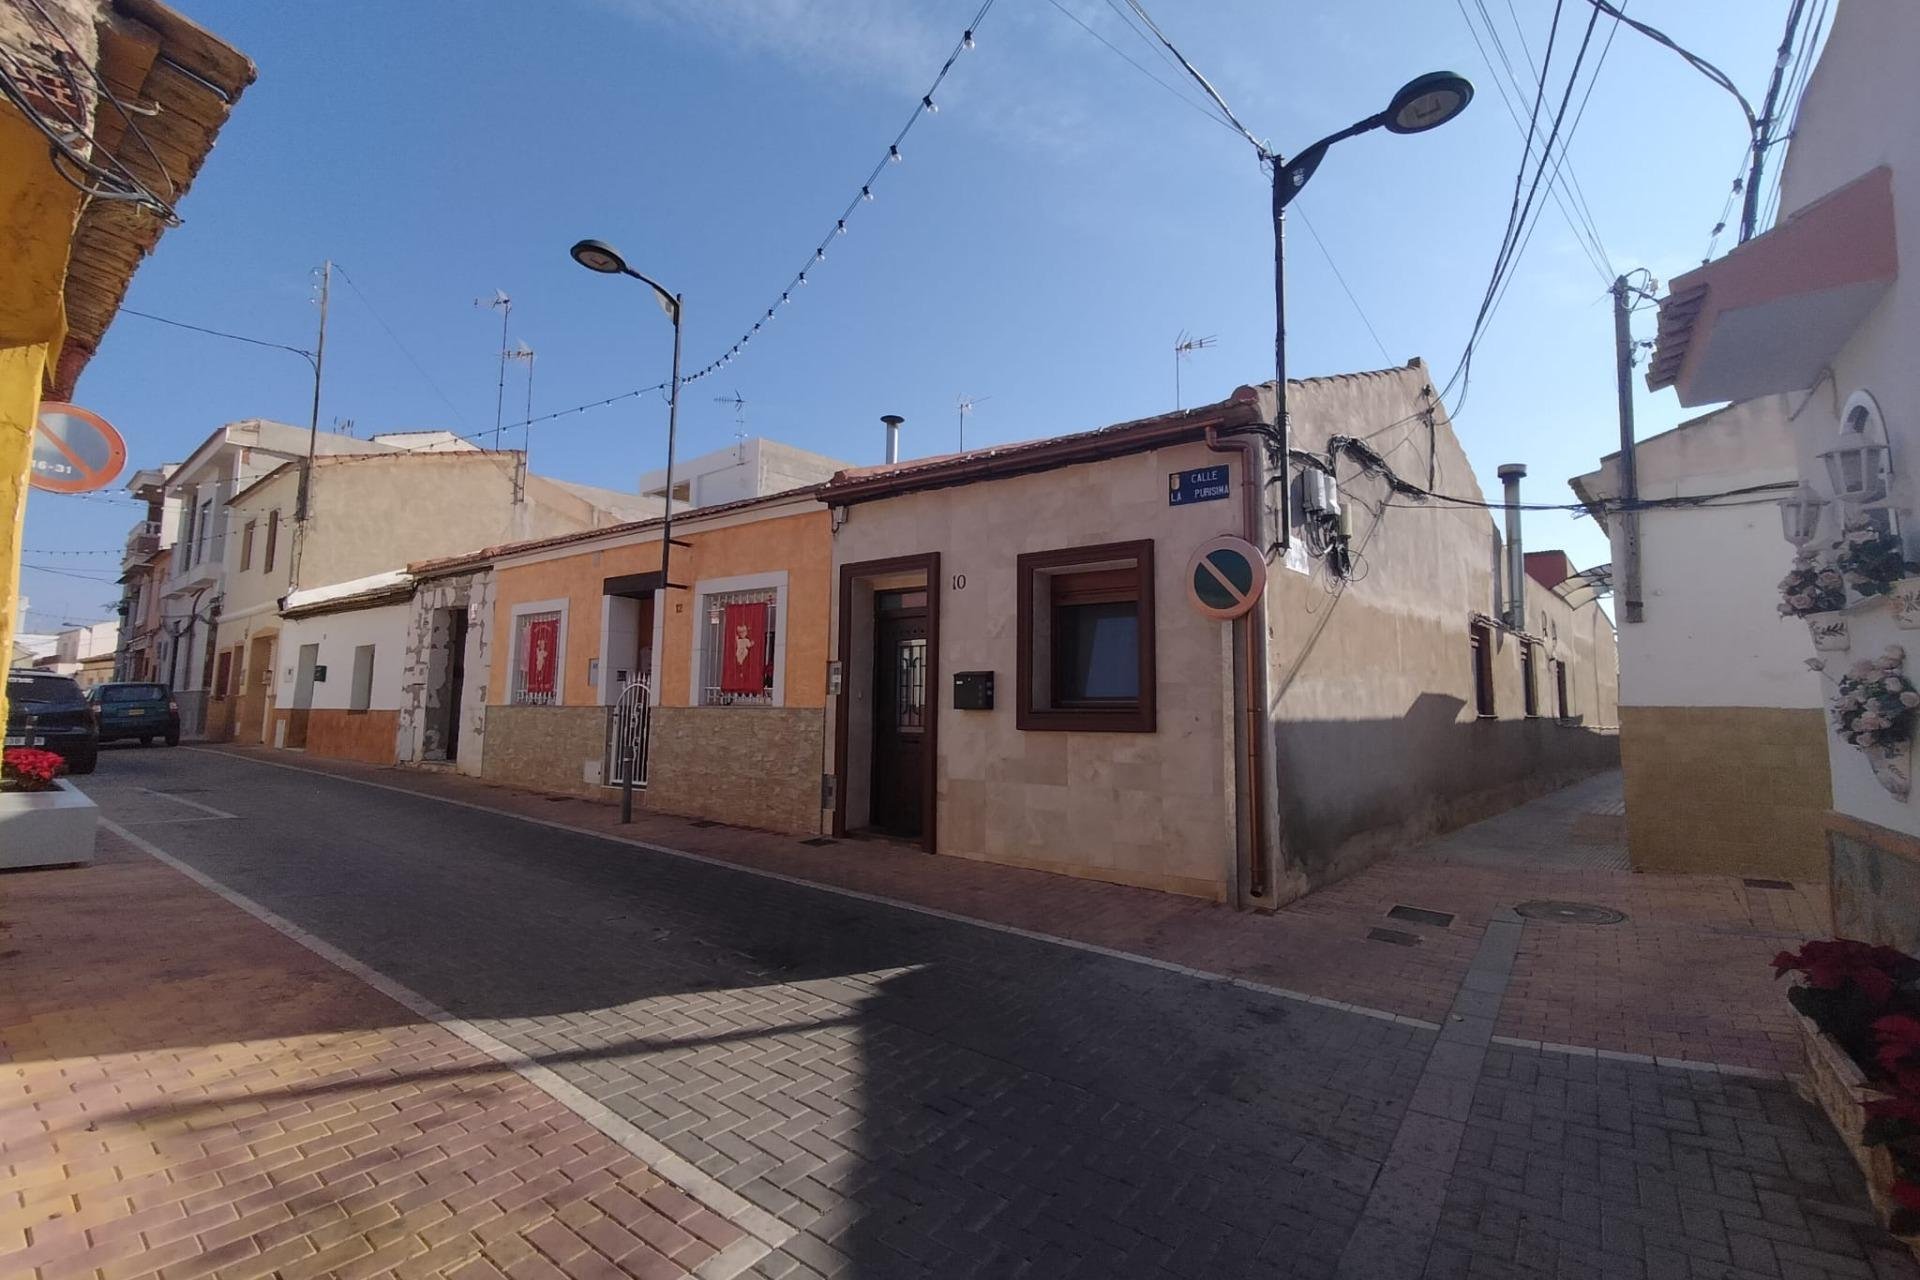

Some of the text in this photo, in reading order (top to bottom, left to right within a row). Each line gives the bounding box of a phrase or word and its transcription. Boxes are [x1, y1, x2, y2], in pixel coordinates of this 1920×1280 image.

[1191, 470, 1218, 483] CALLE
[1170, 484, 1229, 502] LA PURISIMA
[952, 574, 966, 590] 10
